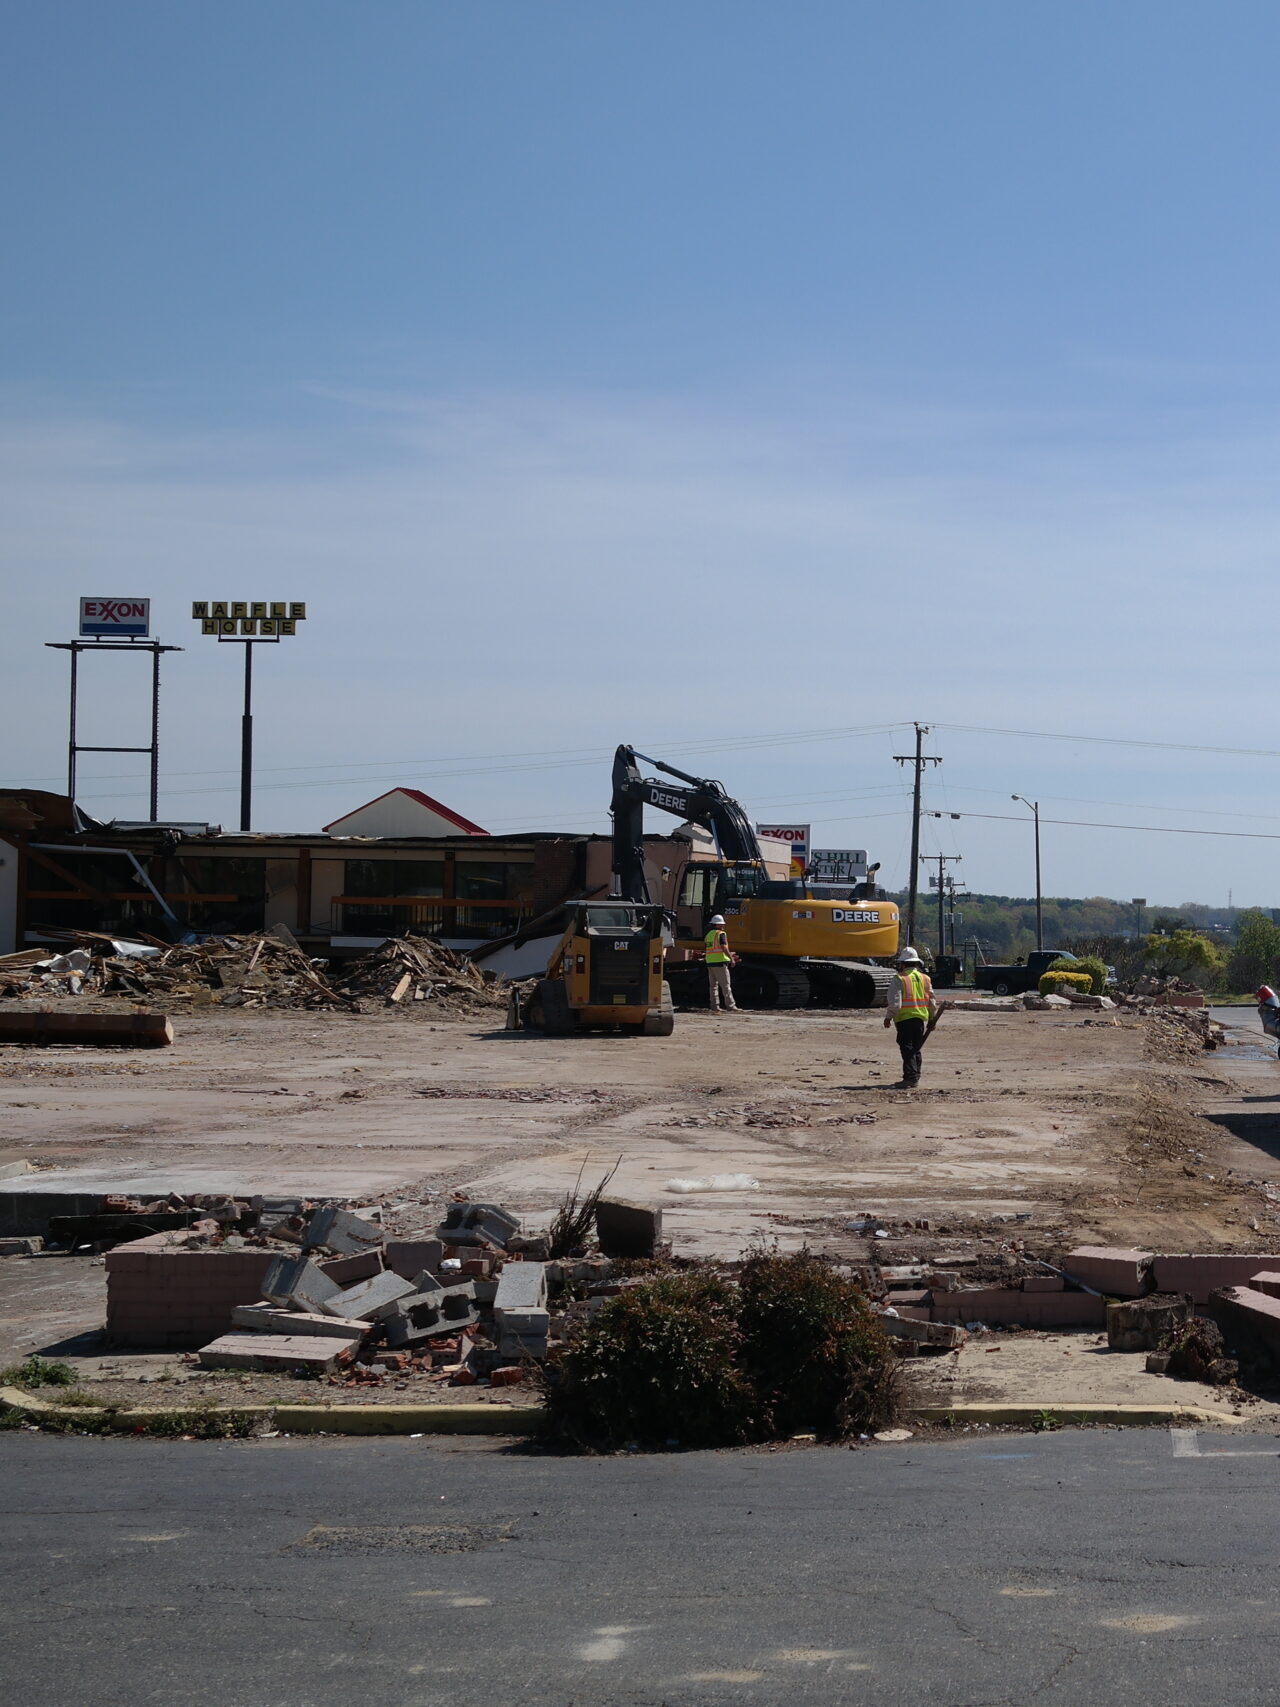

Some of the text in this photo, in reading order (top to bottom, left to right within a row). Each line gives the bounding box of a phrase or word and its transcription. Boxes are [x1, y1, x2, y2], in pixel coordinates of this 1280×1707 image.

[85, 601, 145, 622] EXXON
[194, 602, 302, 616] WAFFLE
[204, 621, 295, 633] HOUSE
[650, 788, 687, 811] DEERE
[761, 829, 805, 841] EXXON
[827, 852, 865, 864] HILL
[816, 864, 845, 875] NTER
[833, 908, 880, 922] DEERE
[614, 941, 629, 951] CAT
